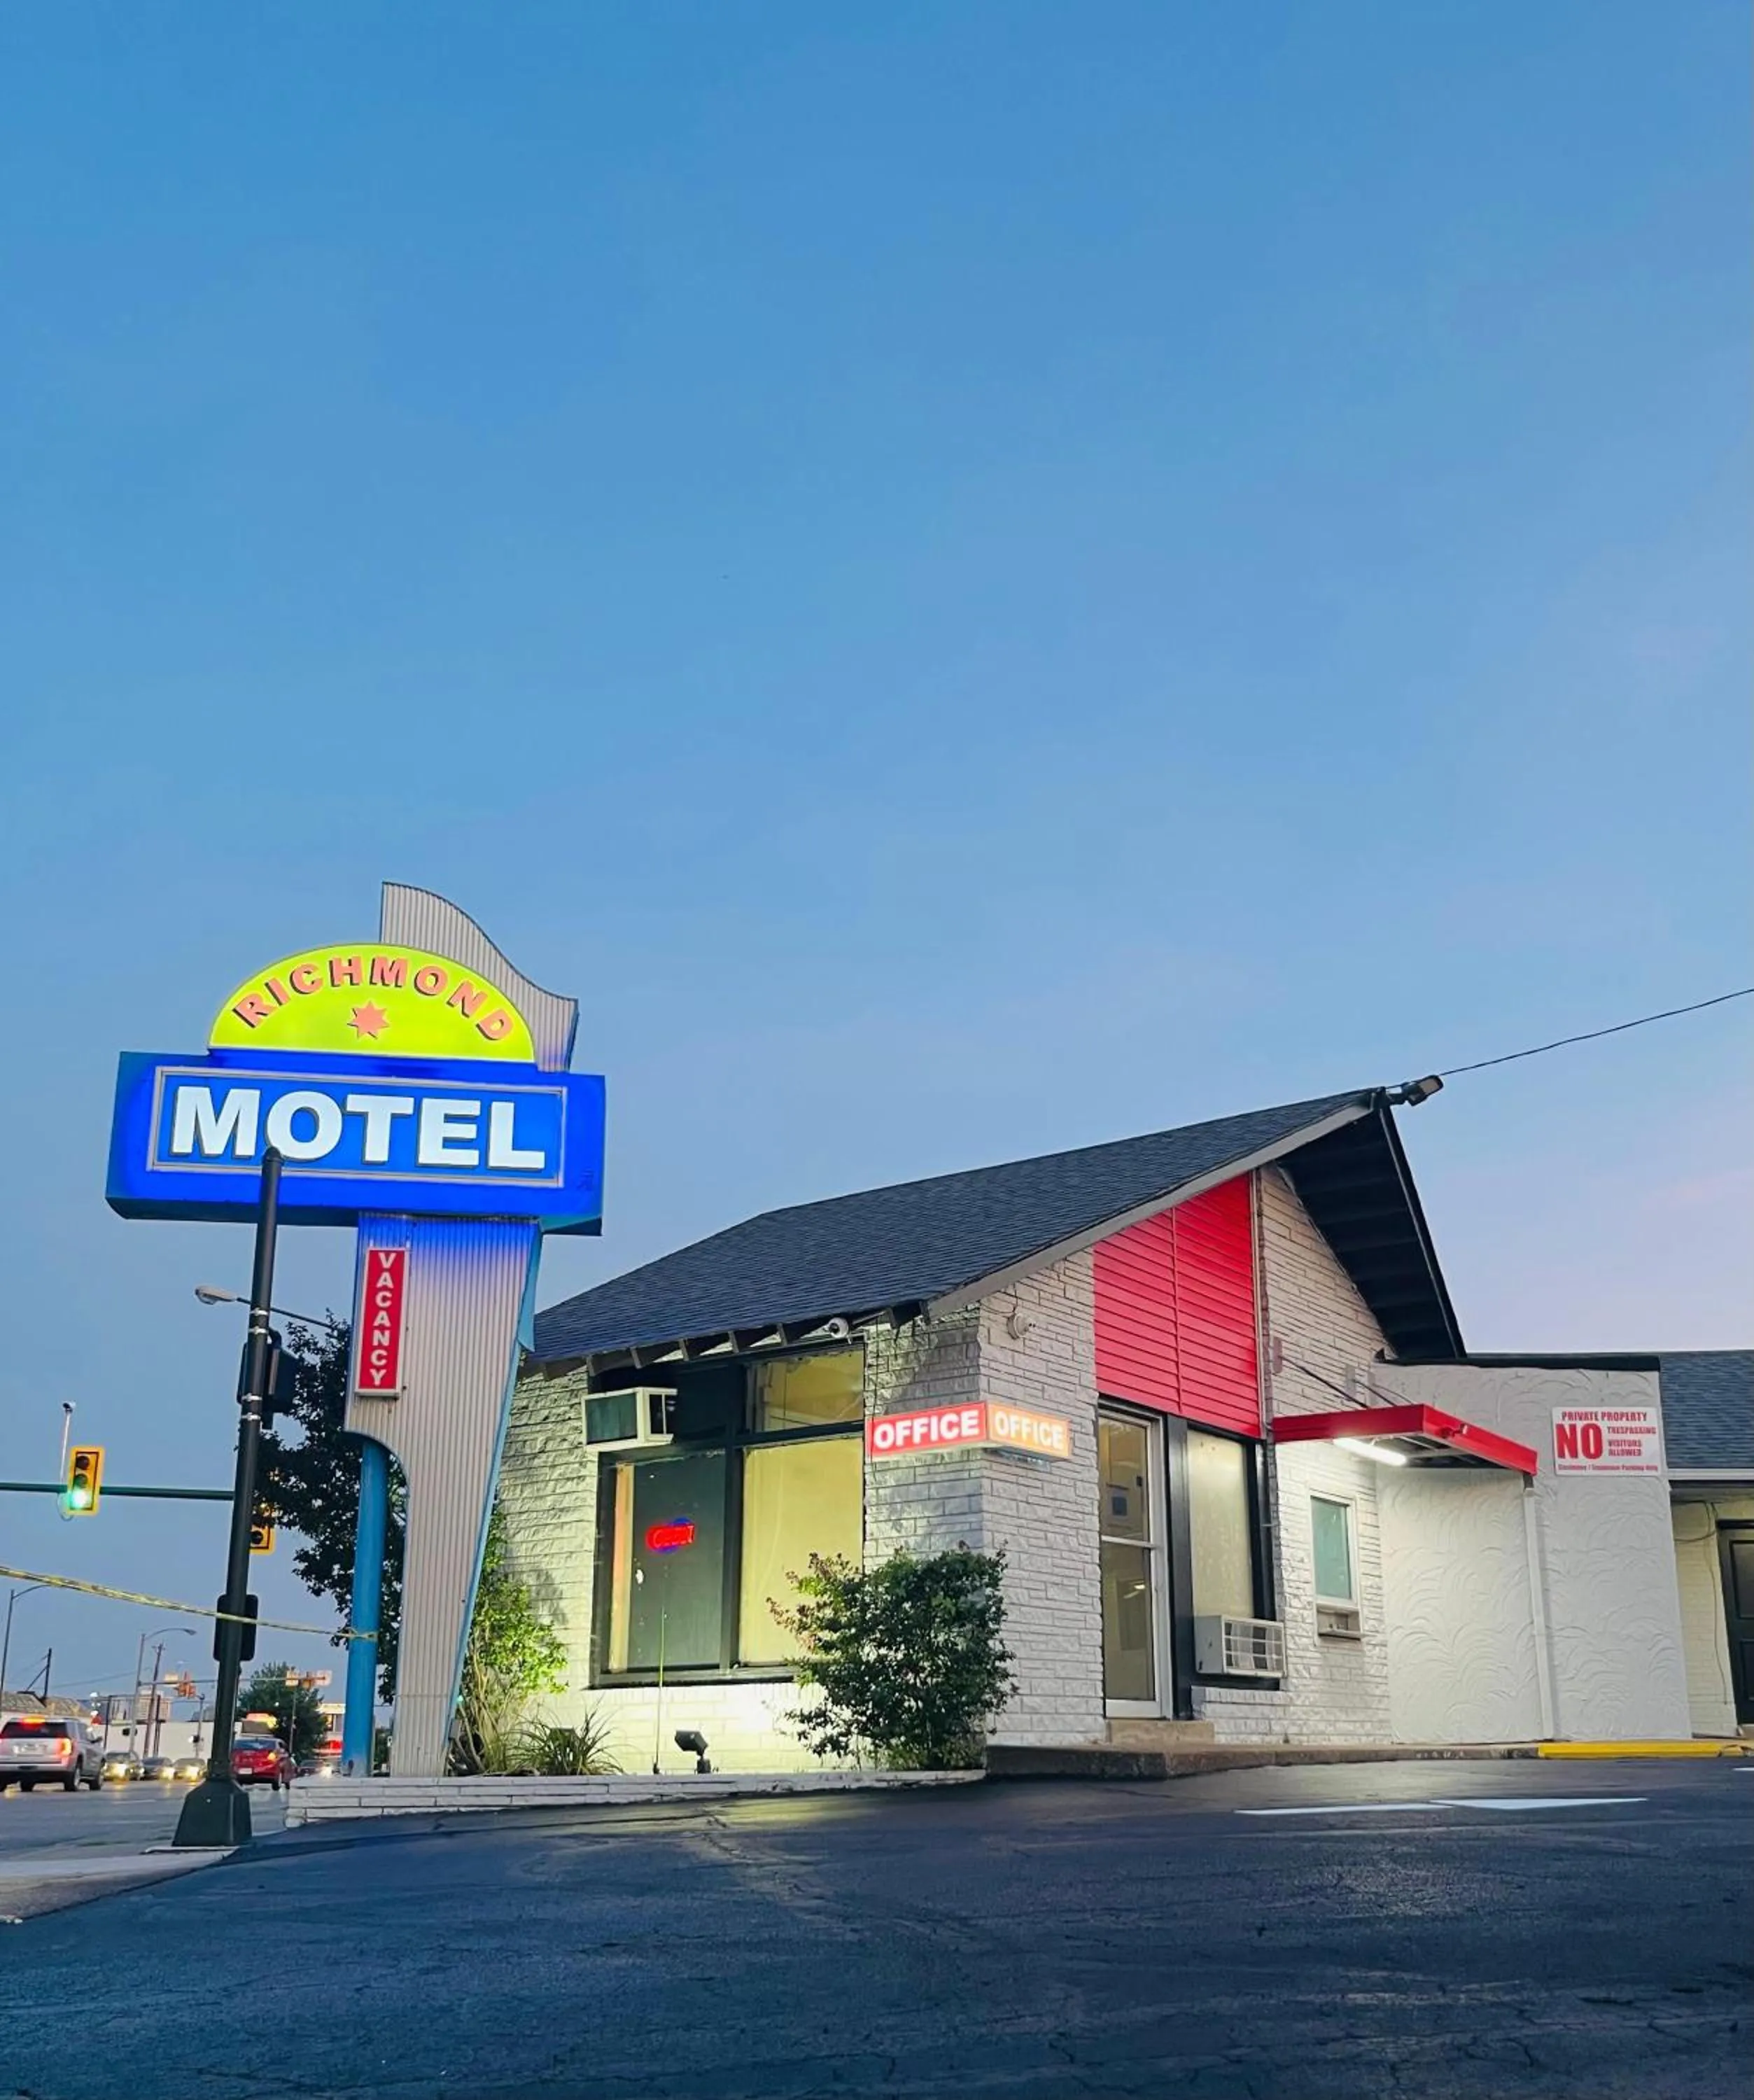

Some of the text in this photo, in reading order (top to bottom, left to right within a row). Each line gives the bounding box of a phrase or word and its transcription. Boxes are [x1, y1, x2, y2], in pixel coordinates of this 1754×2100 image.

[232, 956, 514, 1040] RICHMOND
[170, 1086, 546, 1171] MOTEL
[370, 1252, 396, 1386] VACANCY
[874, 1409, 980, 1449] OFFICE
[995, 1410, 1064, 1450] OFFICE
[1562, 1411, 1647, 1421] PRIVATE PROPERTY
[1607, 1426, 1657, 1434] TRESPASSING
[1555, 1423, 1603, 1460] NO
